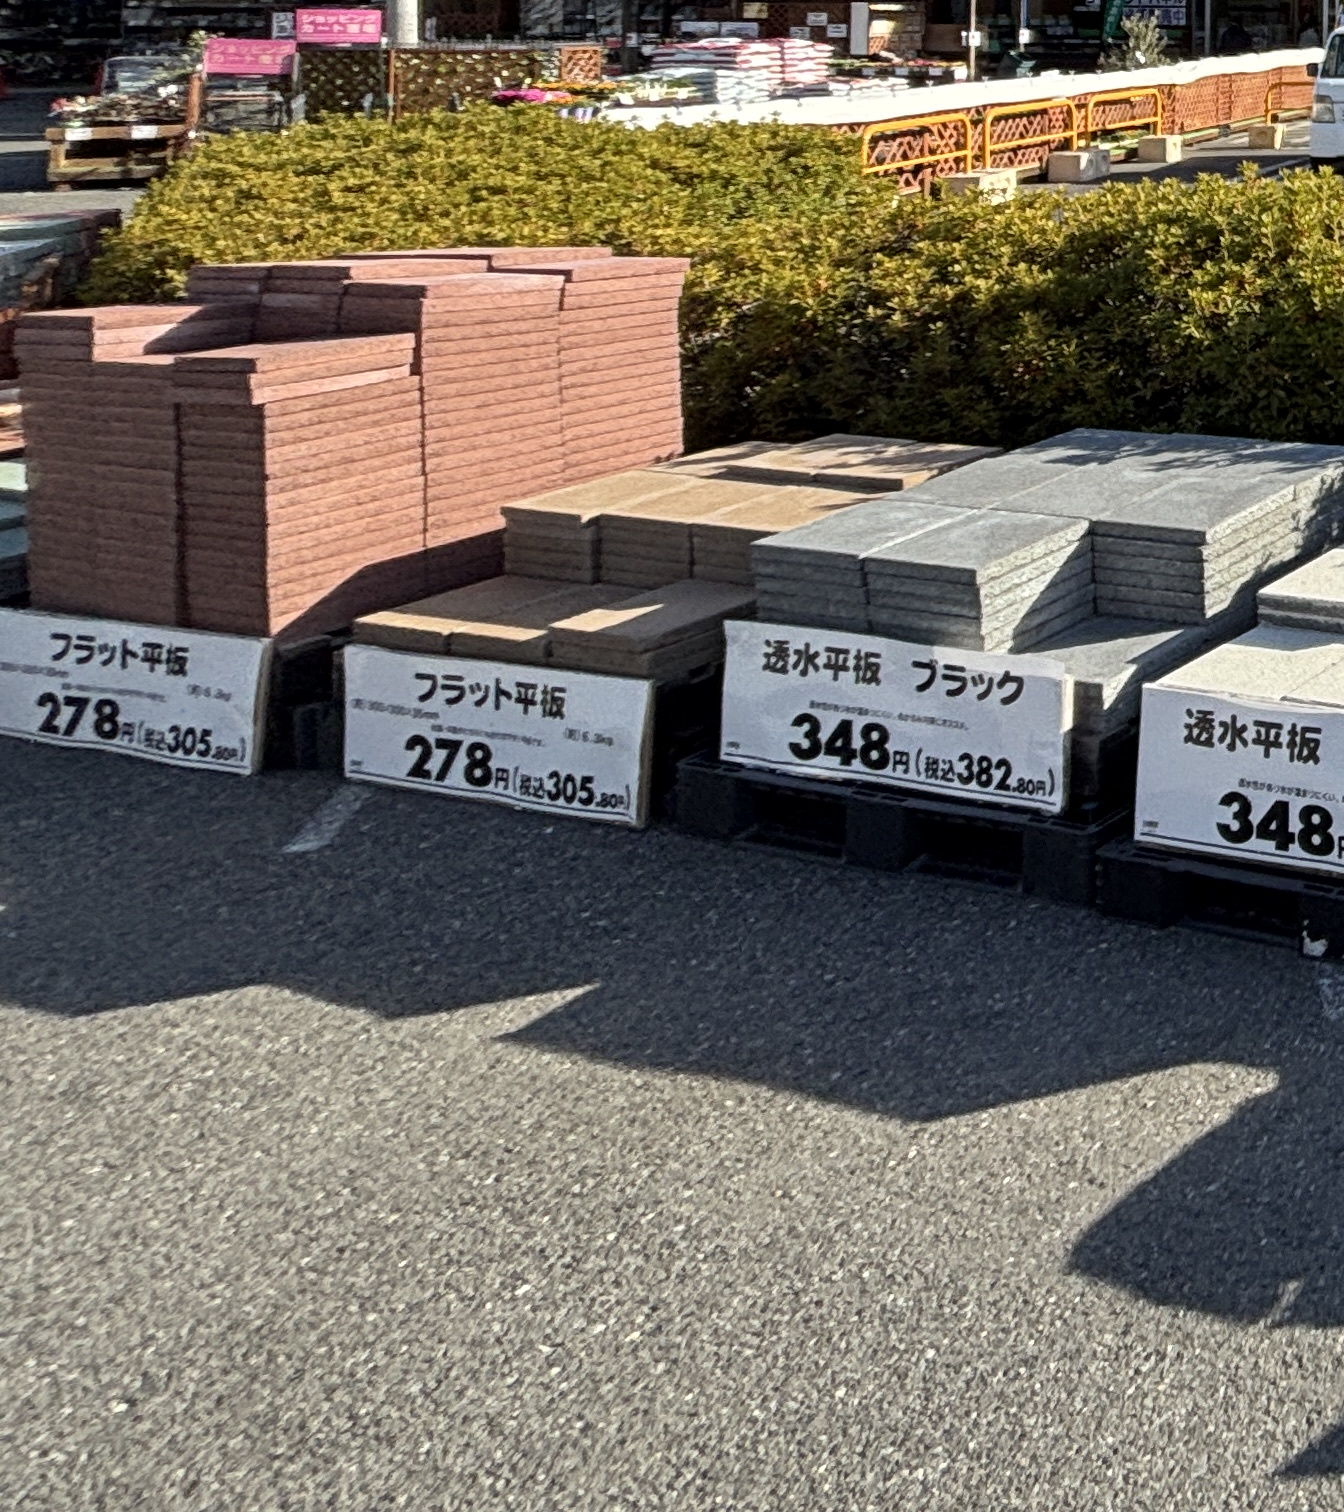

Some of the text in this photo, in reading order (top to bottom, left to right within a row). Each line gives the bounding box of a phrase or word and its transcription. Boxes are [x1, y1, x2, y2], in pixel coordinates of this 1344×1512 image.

[50, 631, 190, 677] フラット平板
[761, 637, 1026, 707] 透水平板 ブラック
[414, 672, 568, 721] フラット平板
[1182, 707, 1323, 767] 透水平板
